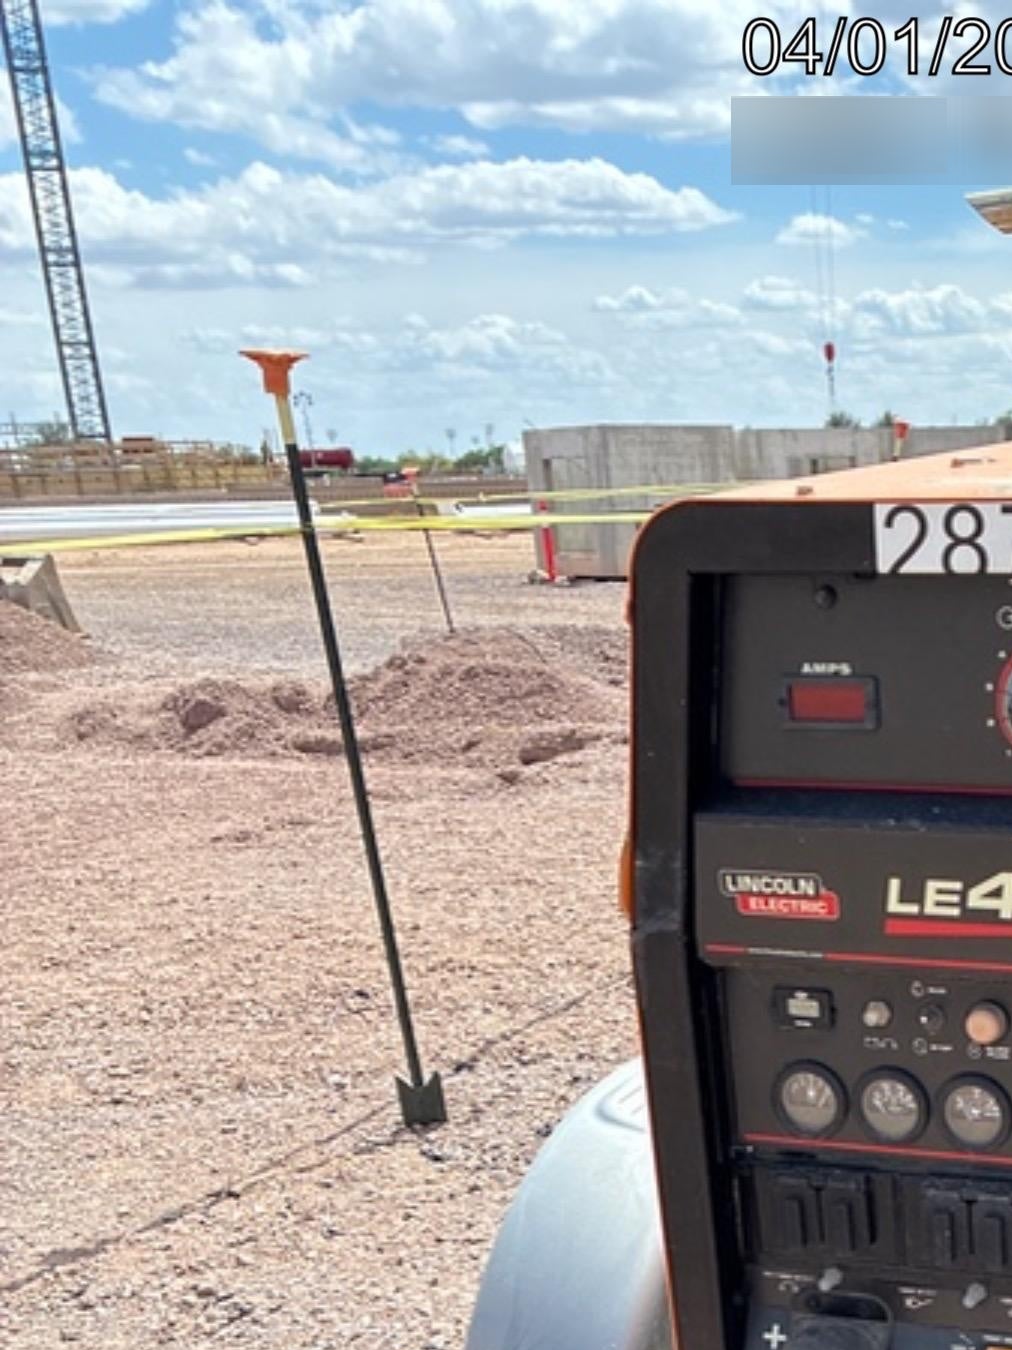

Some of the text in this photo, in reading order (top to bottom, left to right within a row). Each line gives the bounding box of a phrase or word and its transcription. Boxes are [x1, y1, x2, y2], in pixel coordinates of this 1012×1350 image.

[800, 661, 852, 676] AMPS
[725, 874, 817, 896] LINCOLN
[749, 896, 830, 915] ELECTRIC
